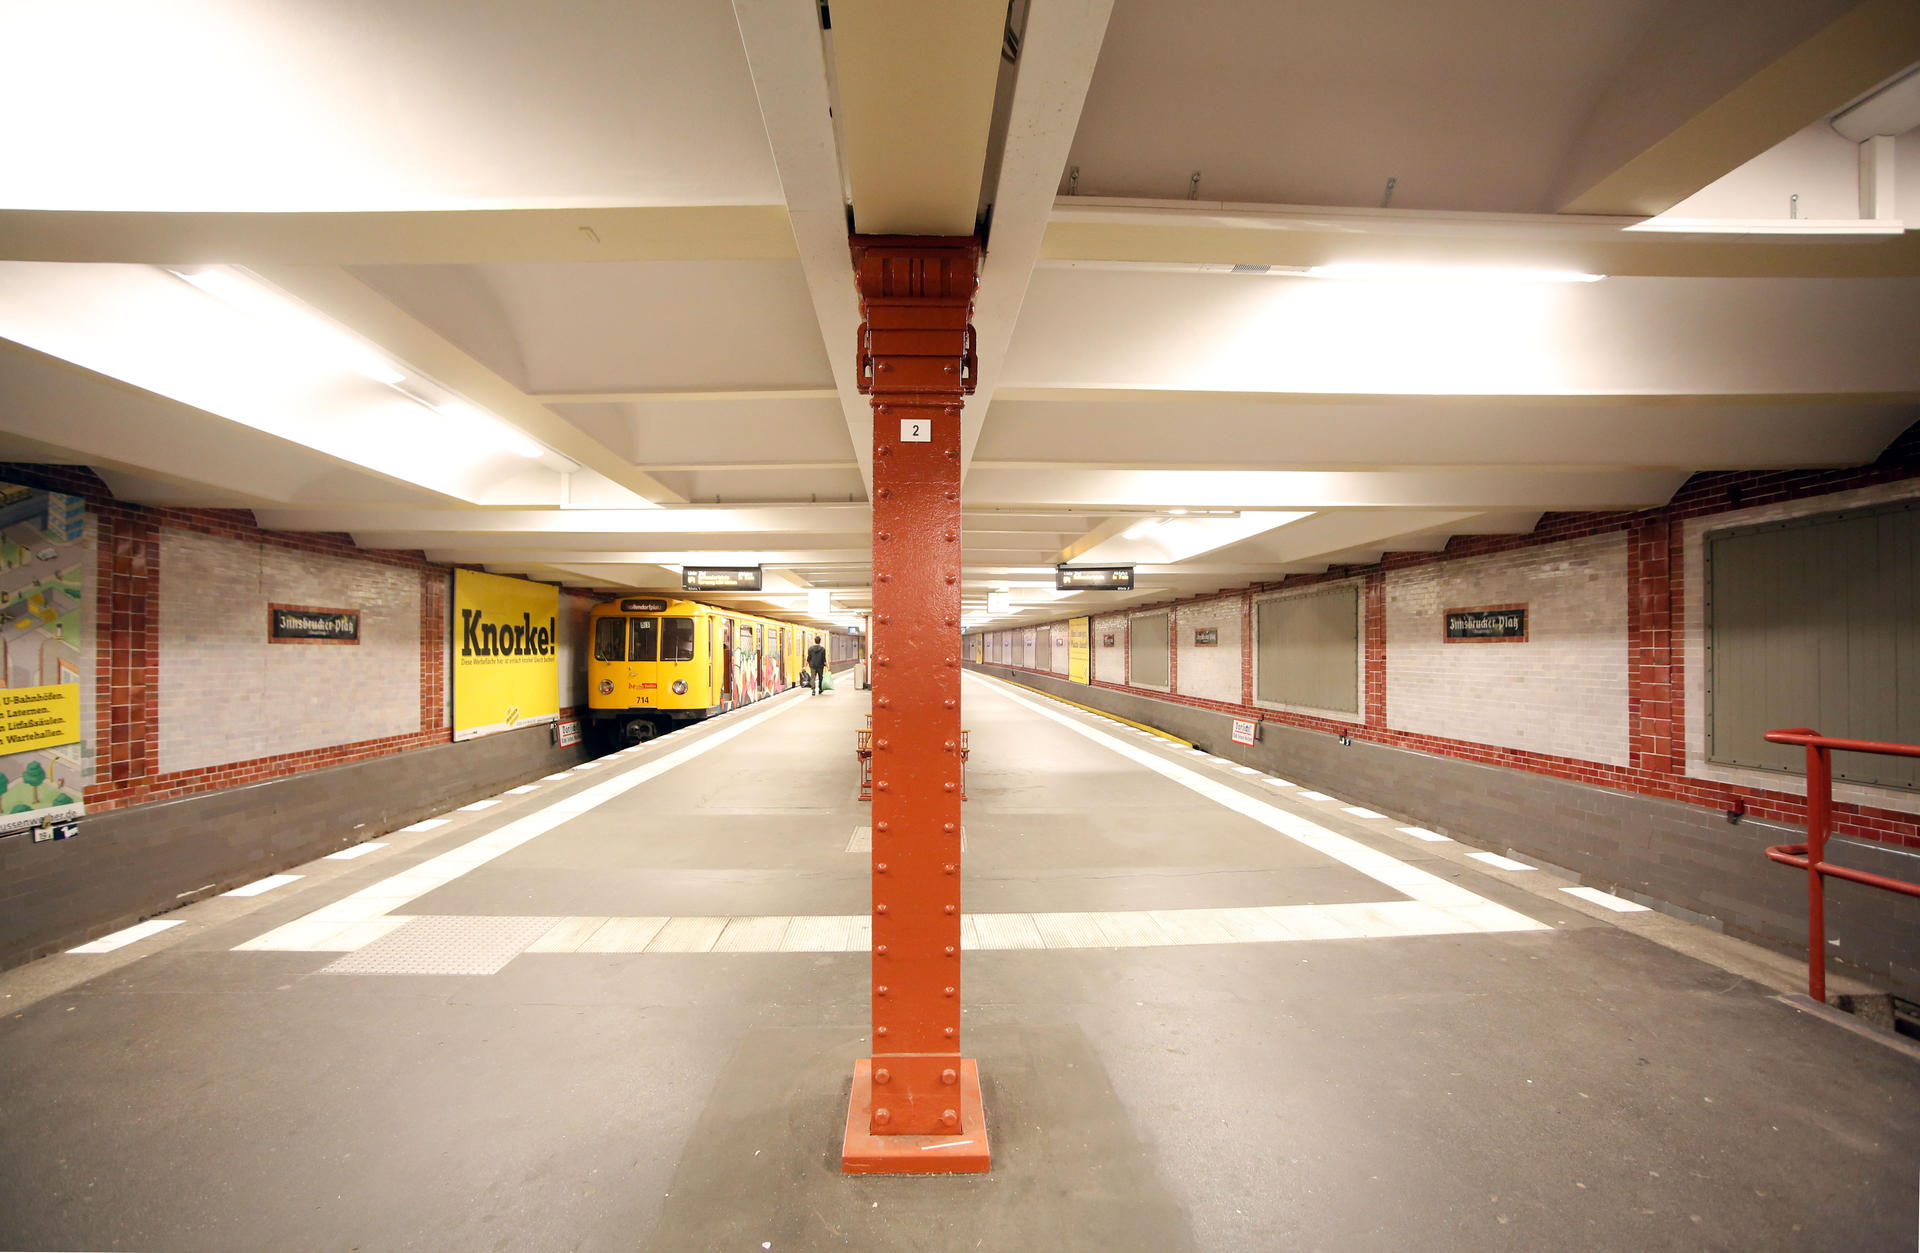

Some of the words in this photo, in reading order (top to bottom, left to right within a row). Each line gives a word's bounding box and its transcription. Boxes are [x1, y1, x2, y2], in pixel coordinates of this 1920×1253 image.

[912, 424, 919, 436] 2
[280, 615, 334, 631] Innsbrucker
[1449, 617, 1496, 631] Innsbrucker
[461, 608, 555, 656] Knorke!
[3, 692, 65, 705] U-Bahnhöfen.
[636, 696, 649, 704] 714
[7, 707, 51, 718] Laternen.
[6, 729, 65, 744] Wartehallen.
